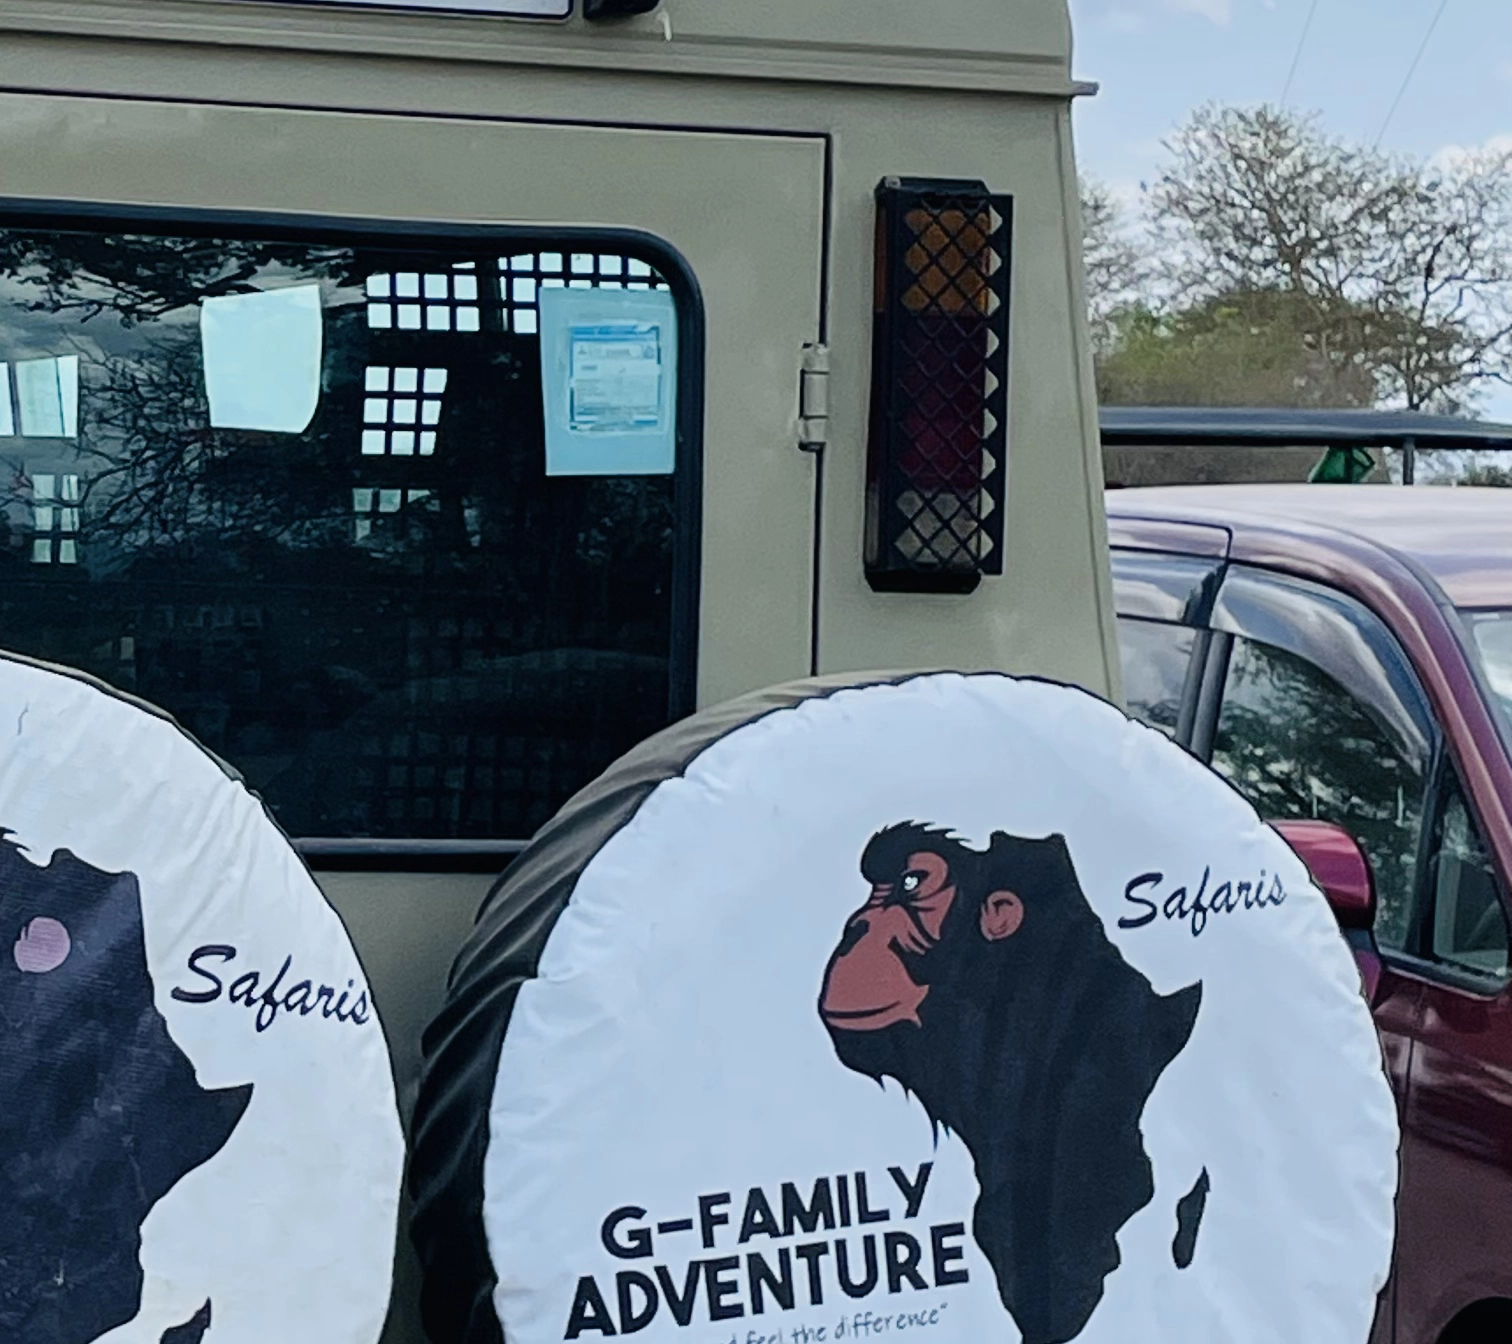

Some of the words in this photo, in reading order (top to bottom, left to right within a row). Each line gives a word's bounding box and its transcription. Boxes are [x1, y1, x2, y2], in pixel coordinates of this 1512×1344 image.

[1117, 864, 1288, 937] Safaris
[170, 944, 370, 1033] Safaris
[600, 1161, 934, 1260] G-FAMILY
[563, 1221, 970, 1341] ADVENTURE
